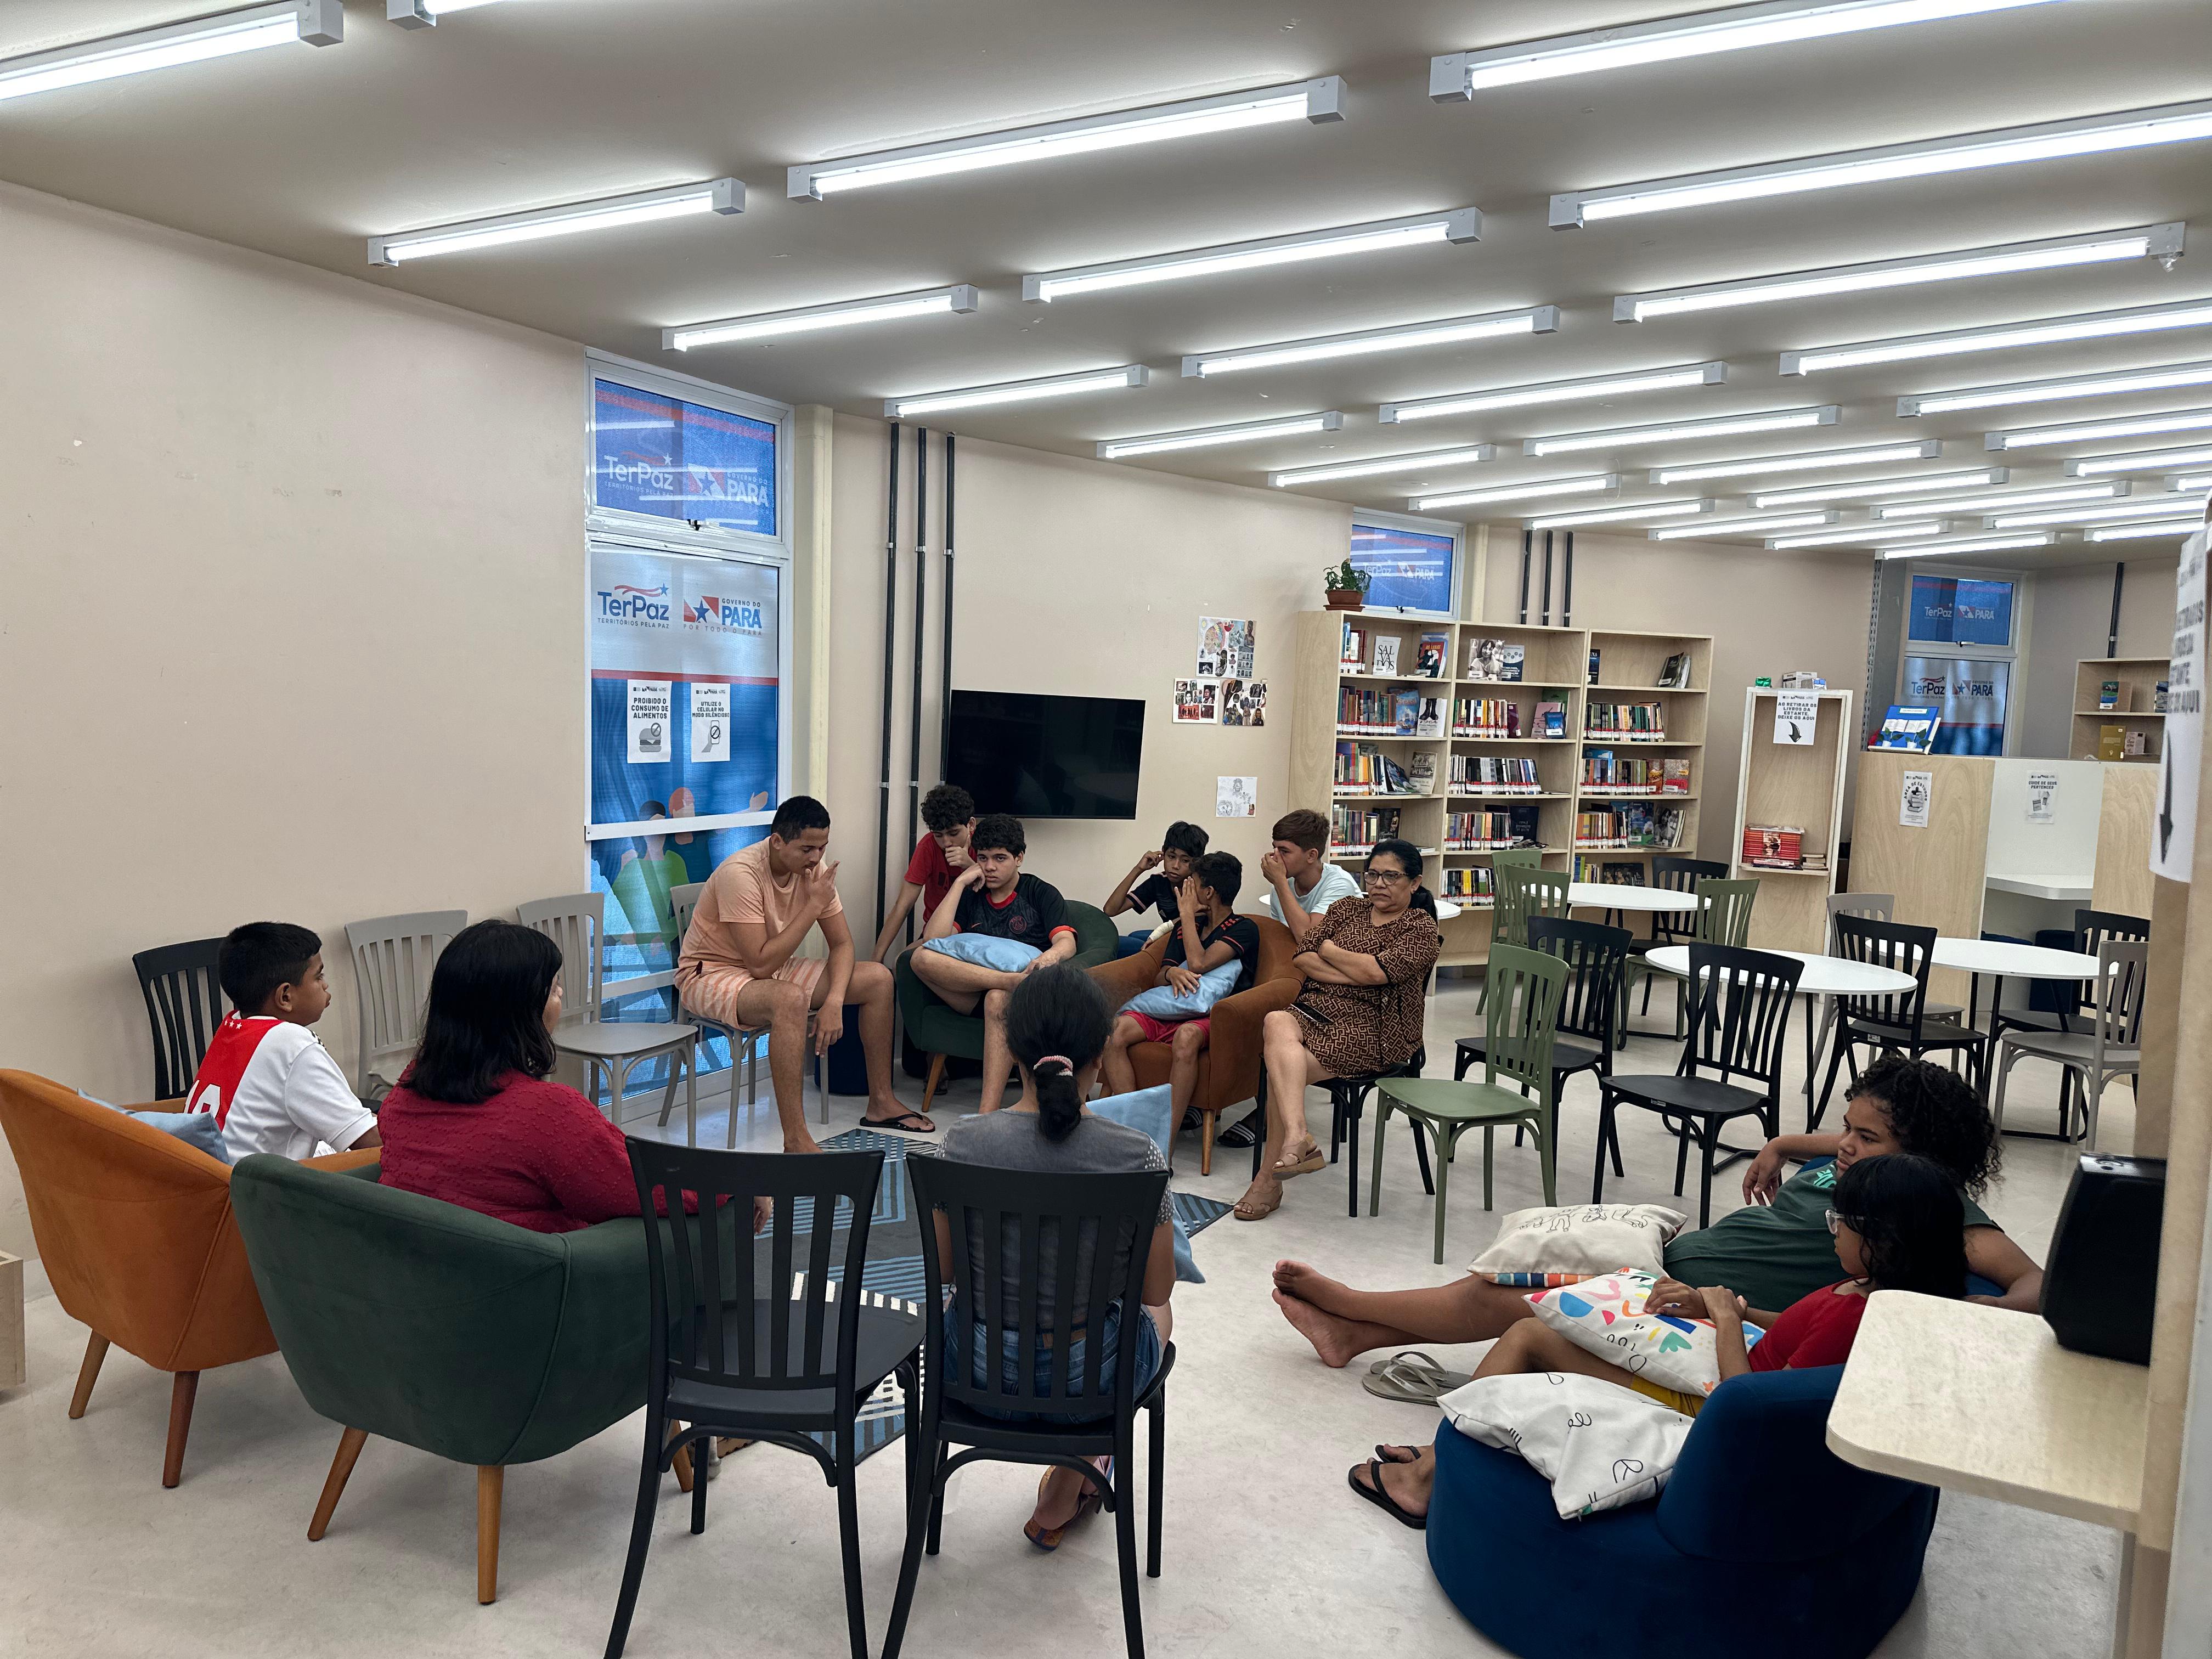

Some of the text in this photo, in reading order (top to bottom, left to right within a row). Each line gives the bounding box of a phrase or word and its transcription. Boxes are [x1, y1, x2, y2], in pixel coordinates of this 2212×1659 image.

[604, 455, 673, 490] TerPaz
[597, 591, 669, 620] TerPaz
[1925, 606, 1952, 617] TerPaz
[597, 618, 639, 626] TERRITÓRIOS
[1911, 681, 1945, 695] TerPaz
